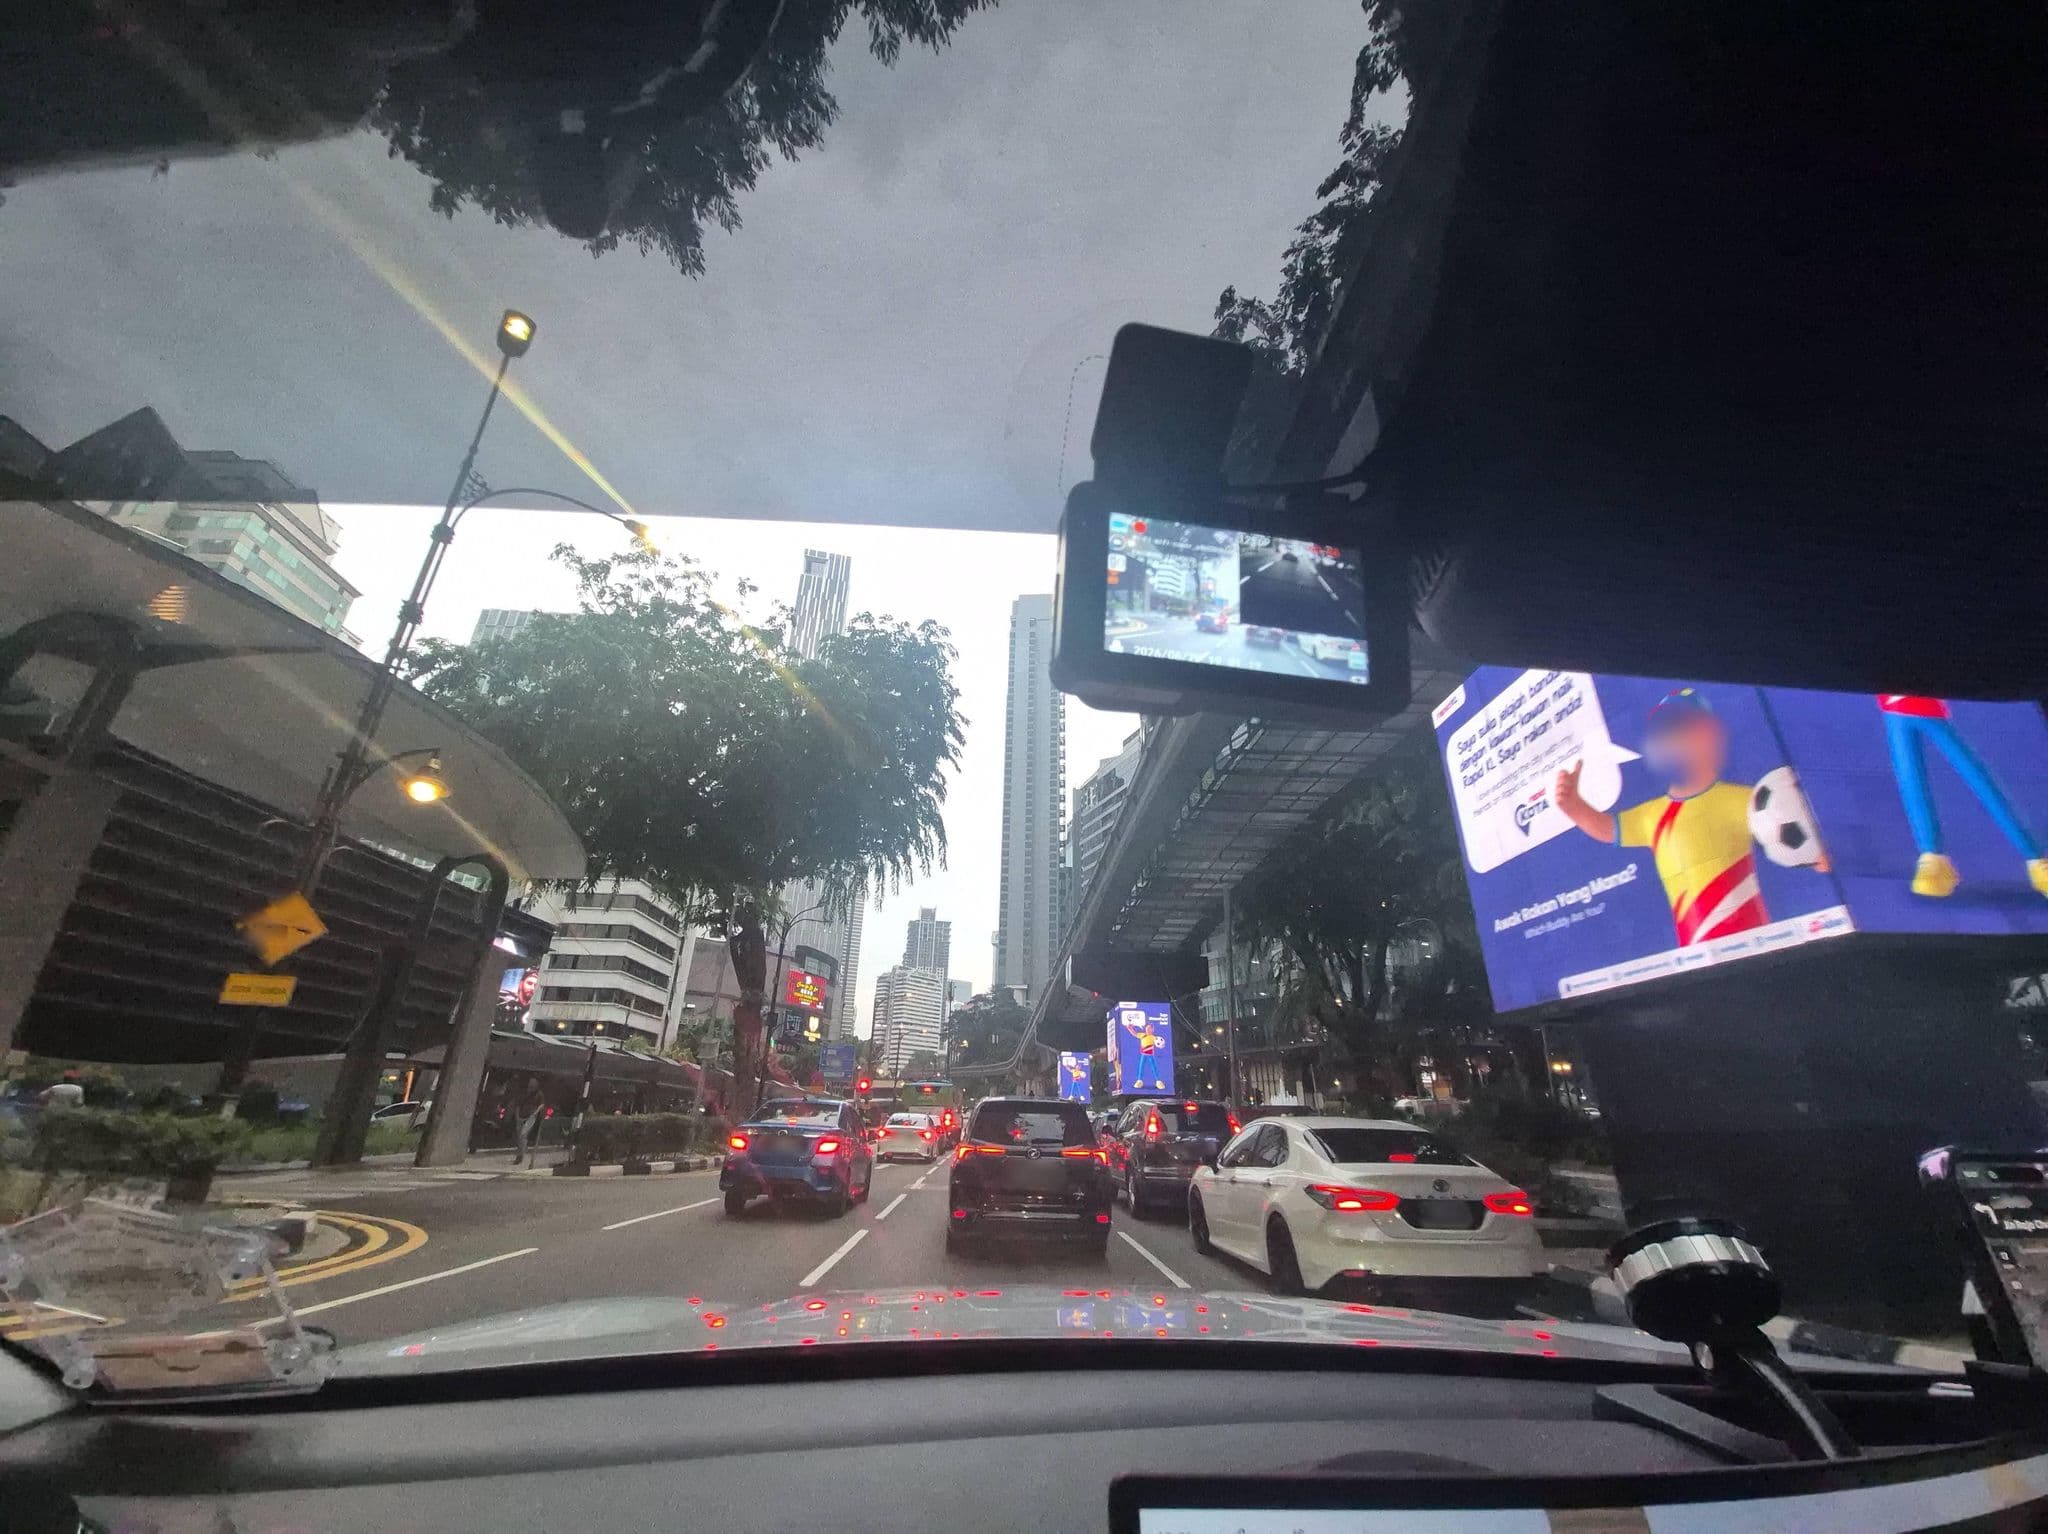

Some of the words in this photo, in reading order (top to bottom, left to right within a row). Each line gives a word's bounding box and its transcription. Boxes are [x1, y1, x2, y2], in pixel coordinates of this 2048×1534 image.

[1457, 734, 1477, 755] Saya
[1498, 740, 1521, 764] Saya
[1523, 717, 1553, 748] rakan
[1520, 799, 1549, 823] KOTA
[1521, 900, 1559, 922] Rakan
[1556, 886, 1592, 907] Yang
[1589, 863, 1638, 896] Mana?
